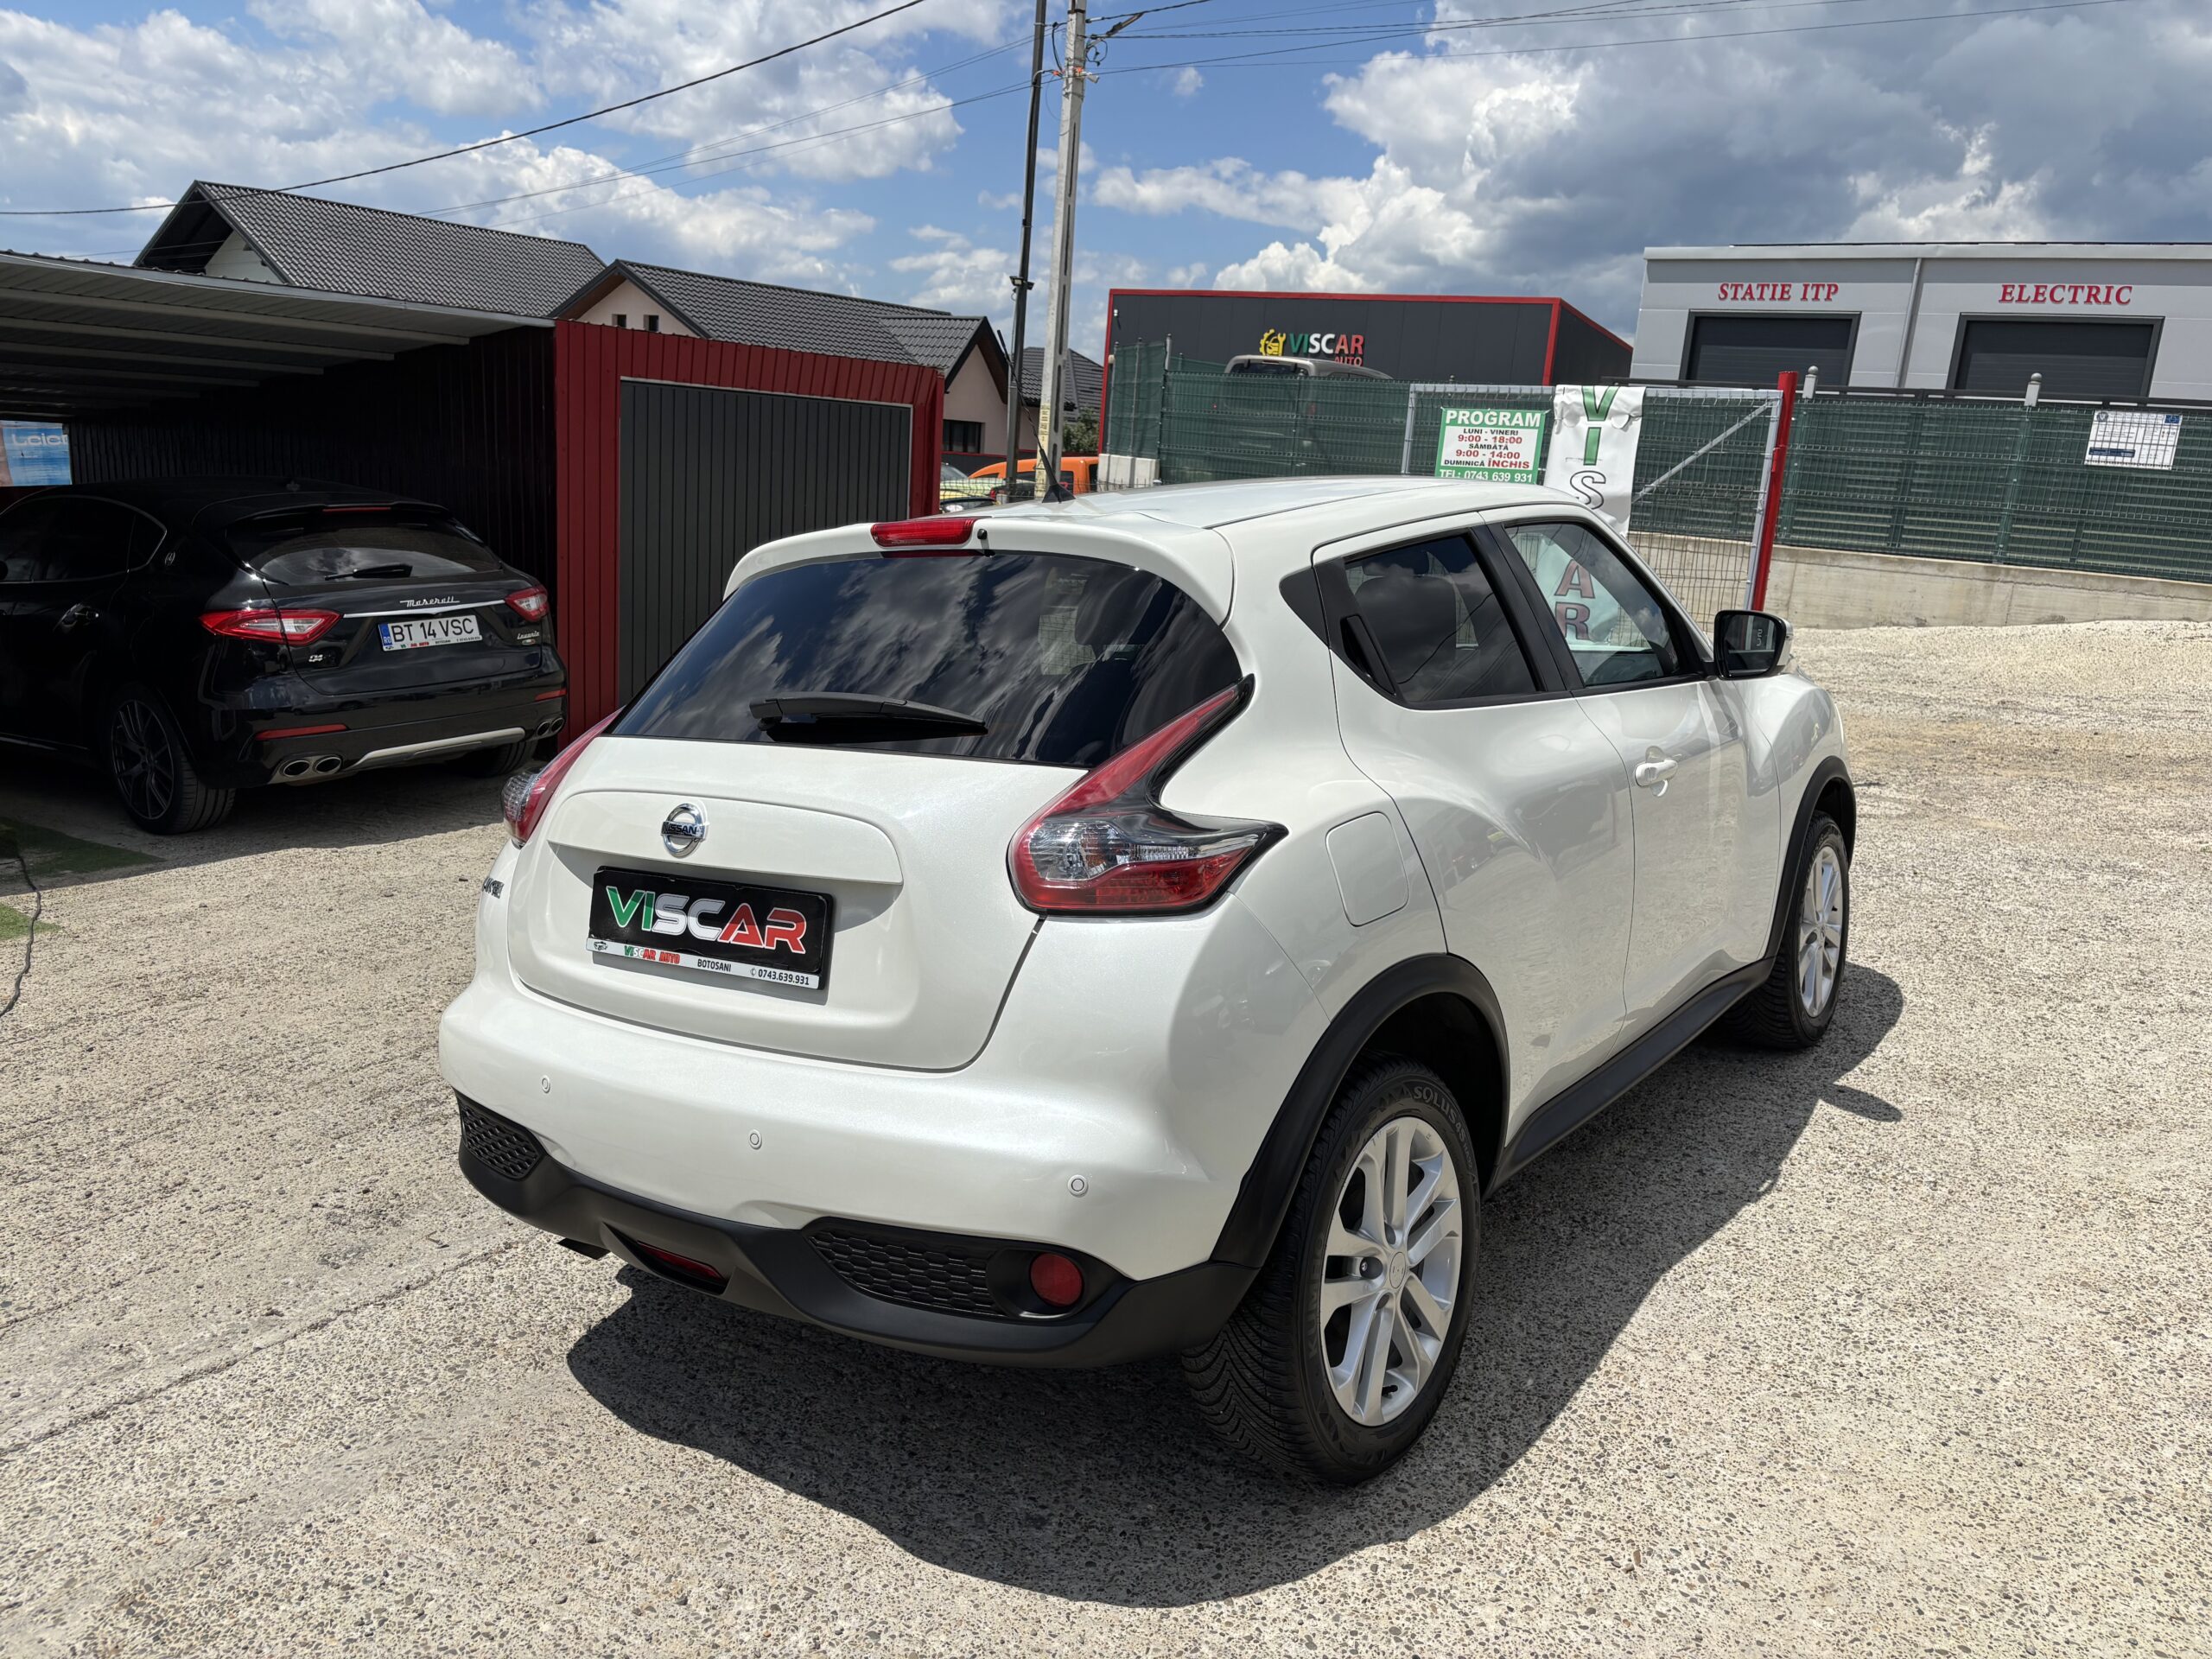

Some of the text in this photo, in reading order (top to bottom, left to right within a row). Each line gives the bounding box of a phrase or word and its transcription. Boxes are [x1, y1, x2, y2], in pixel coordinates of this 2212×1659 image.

[1718, 283, 1839, 302] STATIE ITP
[1999, 284, 2133, 306] ELECTRIC
[1289, 333, 1364, 354] VISCAR
[1334, 356, 1363, 367] AUTO
[1446, 410, 1541, 427] PROGRAM
[1491, 435, 1522, 444] 18:00
[1490, 451, 1521, 460] 14:00
[1464, 471, 1489, 480] 0743
[1491, 472, 1511, 482] 639
[1514, 473, 1533, 483] 931
[391, 618, 474, 642] BT 14 VSC
[662, 822, 697, 835] NISSAN
[606, 885, 807, 955] VISCAR
[624, 945, 810, 986] VISCAR AUTO BOTOSANI 0743.639.931
[1414, 1086, 1457, 1124] SOLUS
